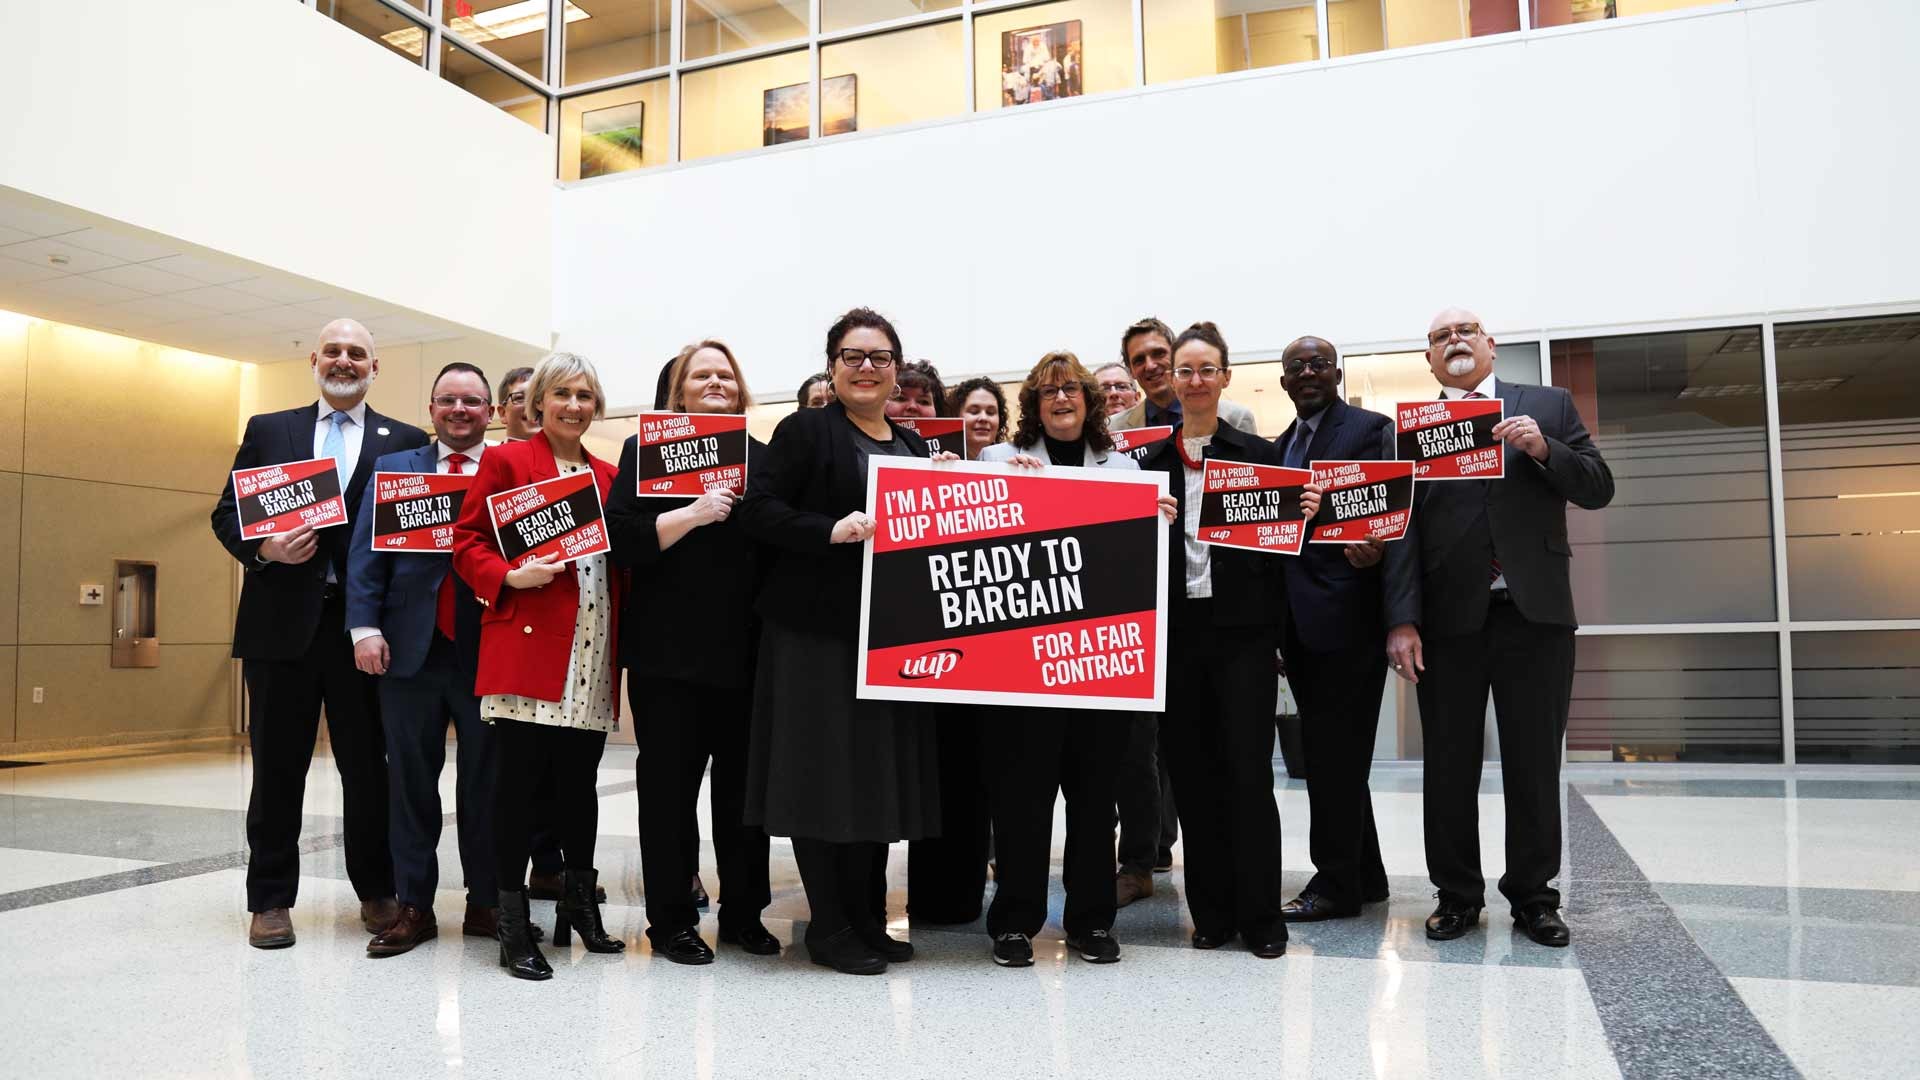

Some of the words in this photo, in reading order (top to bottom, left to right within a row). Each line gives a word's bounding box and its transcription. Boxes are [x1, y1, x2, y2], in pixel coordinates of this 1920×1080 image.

[1412, 408, 1418, 417] A
[1419, 402, 1445, 416] PROUD
[656, 421, 662, 430] A
[663, 416, 690, 429] PROUD
[1402, 419, 1417, 429] UUP
[1419, 411, 1451, 425] MEMBER
[645, 431, 661, 442] UUP
[663, 425, 696, 439] MEMBER
[1417, 424, 1456, 445] READY
[1458, 421, 1473, 435] TO
[660, 440, 699, 459] READY
[701, 437, 718, 451] TO
[925, 439, 940, 451] TO
[1422, 435, 1475, 458] BARGAIN
[665, 451, 719, 473] BARGAIN
[1456, 455, 1473, 466] FOR
[1473, 453, 1479, 463] A
[1479, 449, 1497, 460] FAIR
[1460, 458, 1499, 475] CONTRACT
[257, 467, 283, 478] PROUD
[700, 472, 715, 483] FOR
[717, 470, 723, 479] A
[723, 468, 741, 478] FAIR
[1221, 469, 1227, 477] A
[1228, 467, 1254, 477] PROUD
[1328, 469, 1334, 478] A
[1334, 464, 1360, 476] PROUD
[1415, 465, 1430, 475] up
[241, 486, 257, 494] UUP
[259, 474, 290, 490] MEMBER
[393, 480, 398, 488] A
[399, 475, 424, 488] PROUD
[1209, 479, 1225, 489] UUP
[1227, 477, 1259, 488] MEMBER
[1333, 473, 1366, 487] MEMBER
[258, 485, 295, 506] READY
[297, 480, 313, 491] TO
[381, 490, 396, 500] UUP
[398, 484, 430, 497] MEMBER
[508, 499, 513, 507] A
[512, 487, 538, 504] PROUD
[921, 486, 936, 510] A
[938, 478, 1008, 509] PROUD
[1223, 492, 1261, 508] READY
[1264, 491, 1280, 505] TO
[1331, 487, 1368, 507] READY
[1371, 484, 1387, 498] TO
[264, 491, 316, 516] BARGAIN
[300, 509, 316, 519] FOR
[315, 507, 321, 516] A
[321, 500, 338, 513] FAIR
[396, 498, 432, 516] READY
[435, 496, 450, 509] TO
[499, 511, 513, 523] UUP
[515, 494, 547, 515] MEMBER
[1335, 498, 1388, 520] BARGAIN
[304, 508, 341, 525] CONTRACT
[400, 509, 451, 529] BARGAIN
[515, 508, 553, 535] READY
[554, 500, 571, 519] TO
[888, 514, 931, 542] UUP
[937, 502, 1025, 536] MEMBER
[1226, 505, 1278, 522] BARGAIN
[1369, 519, 1384, 529] FOR
[1385, 517, 1391, 525] A
[1391, 513, 1405, 522] FAIR
[432, 528, 447, 539] FOR
[523, 514, 576, 547] BARGAIN
[560, 534, 577, 548] FOR
[577, 531, 583, 541] A
[582, 524, 600, 537] FAIR
[1258, 526, 1273, 536] FOR
[1274, 525, 1280, 534] A
[1281, 524, 1298, 534] FAIR
[1372, 522, 1405, 537] CONTRACT
[566, 533, 604, 556] CONTRACT
[1259, 534, 1298, 546] CONTRACT
[928, 542, 1032, 591] READY
[1041, 536, 1083, 575] TO
[940, 574, 1084, 629] BARGAIN
[1032, 632, 1075, 660] FOR
[1079, 629, 1094, 654] A
[1096, 622, 1142, 650] FAIR
[904, 651, 957, 679] uup
[1041, 649, 1145, 687] CONTRACT
